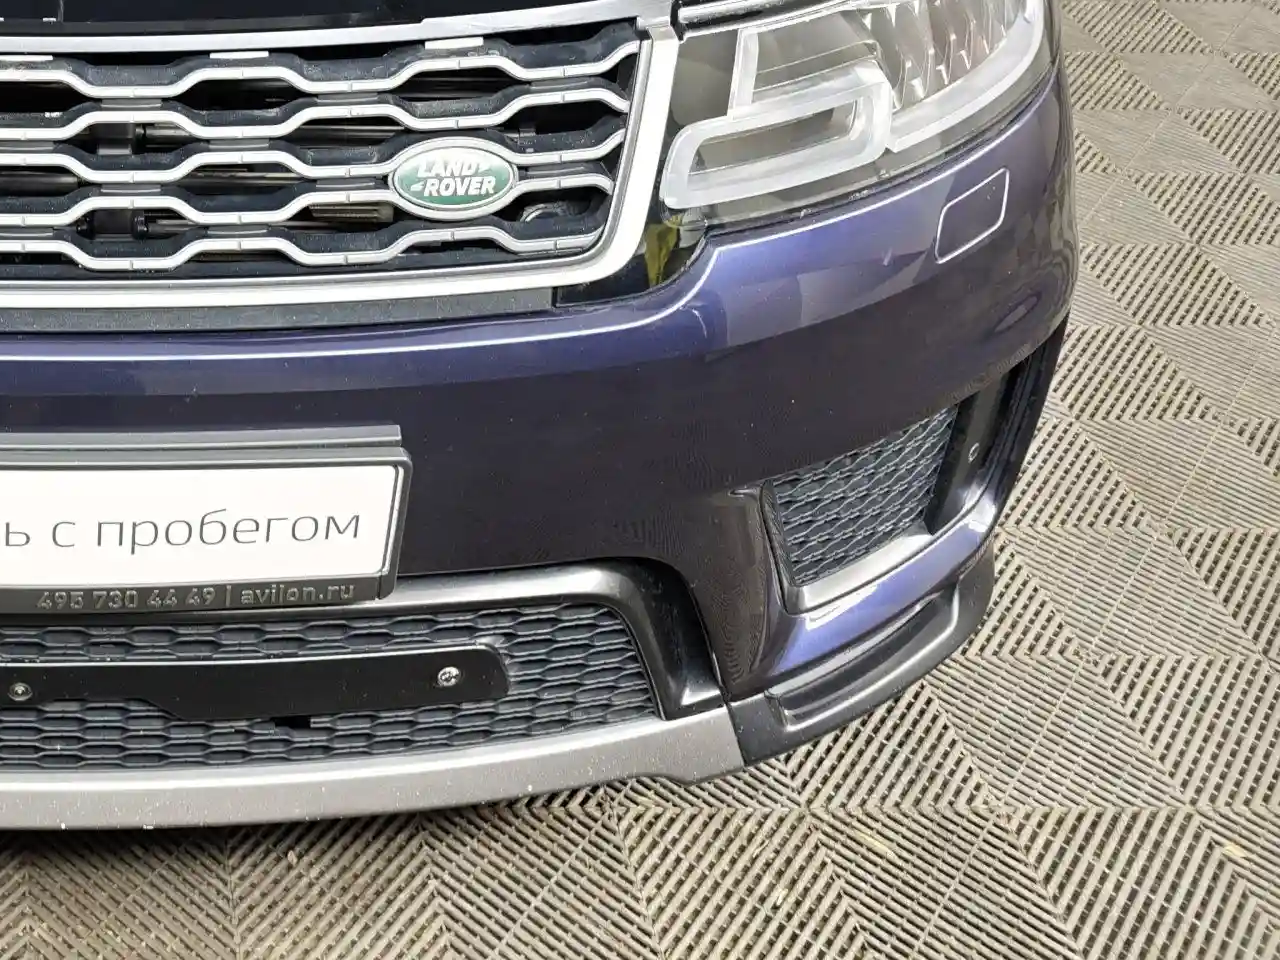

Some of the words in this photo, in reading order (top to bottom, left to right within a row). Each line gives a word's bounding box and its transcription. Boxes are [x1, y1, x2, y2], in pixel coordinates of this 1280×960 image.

[417, 158, 478, 177] LAND
[423, 176, 496, 197] ROVER
[51, 520, 76, 548] с
[97, 508, 361, 555] пробегом
[35, 591, 84, 610] 495
[92, 590, 139, 609] 730
[146, 589, 178, 609] 44
[184, 587, 216, 606] 49
[240, 584, 355, 606] avilon.ru
